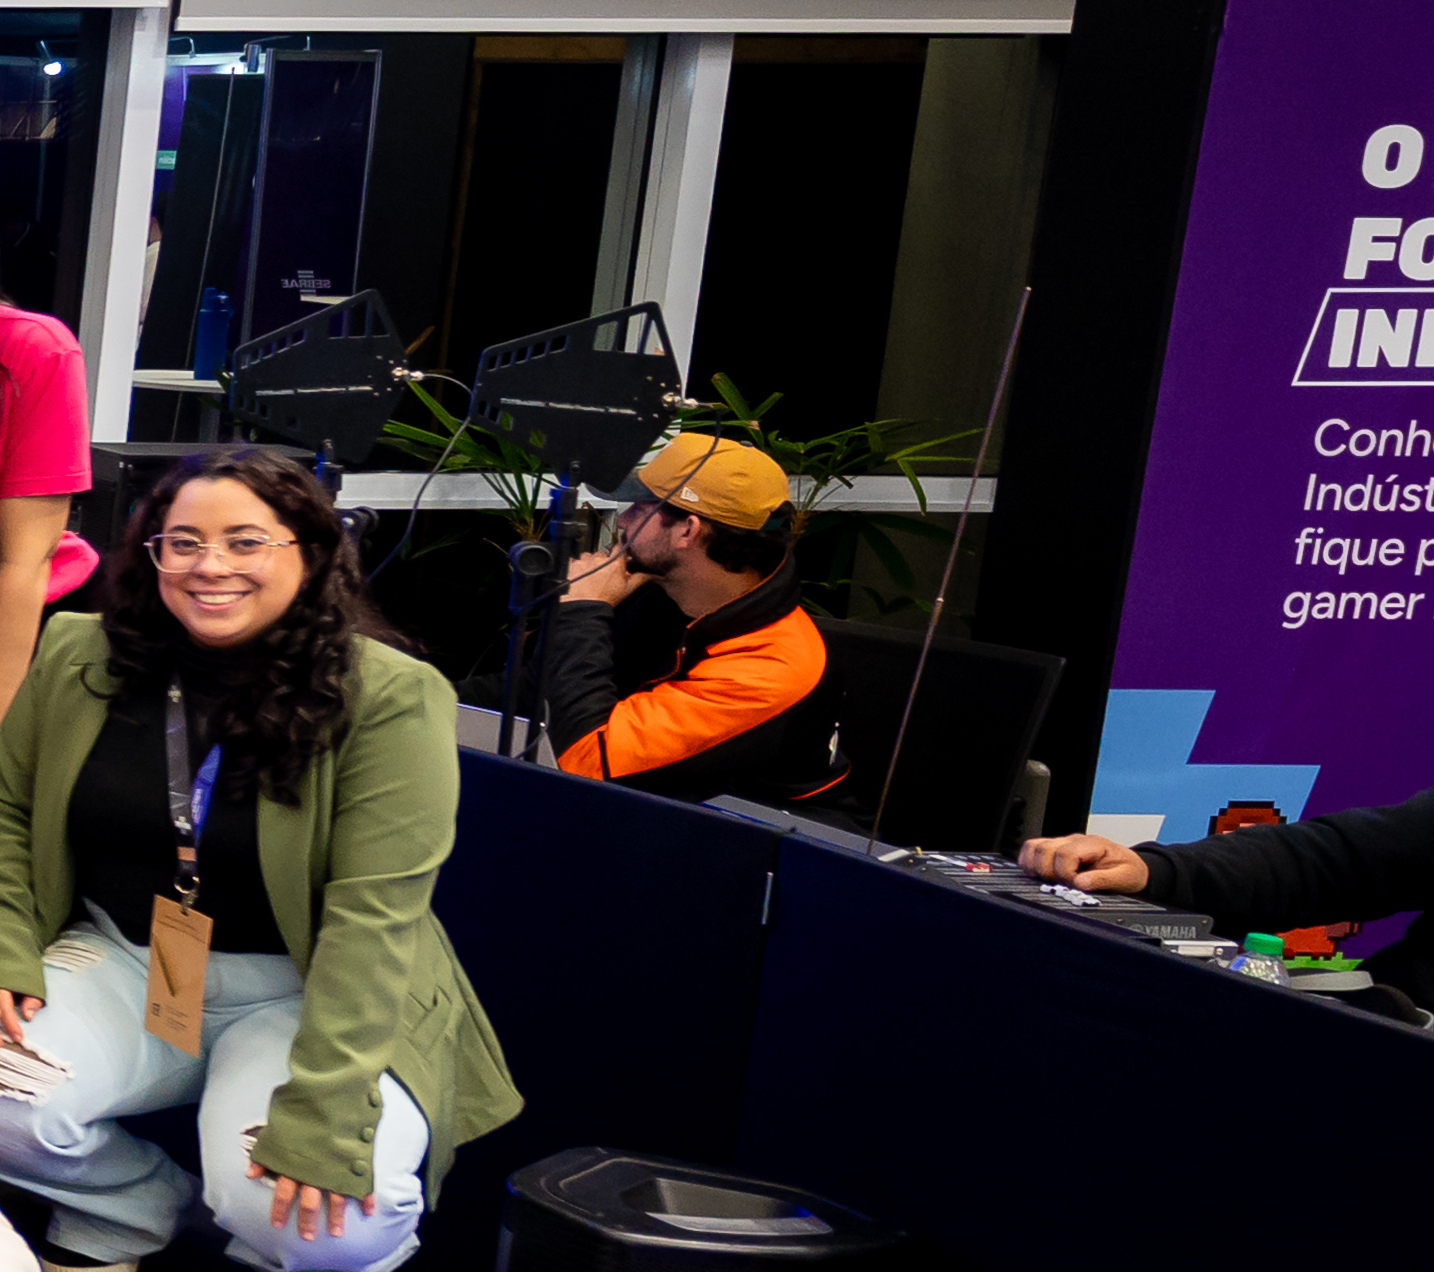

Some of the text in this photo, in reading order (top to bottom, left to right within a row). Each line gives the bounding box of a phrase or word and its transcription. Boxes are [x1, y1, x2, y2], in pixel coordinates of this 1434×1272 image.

[1362, 124, 1424, 189] O
[1314, 418, 1434, 457] Conh
[1303, 473, 1434, 512] Indúst
[1295, 527, 1405, 575] fique
[1282, 591, 1425, 629] gamer
[1146, 925, 1197, 939] YAMAHA
